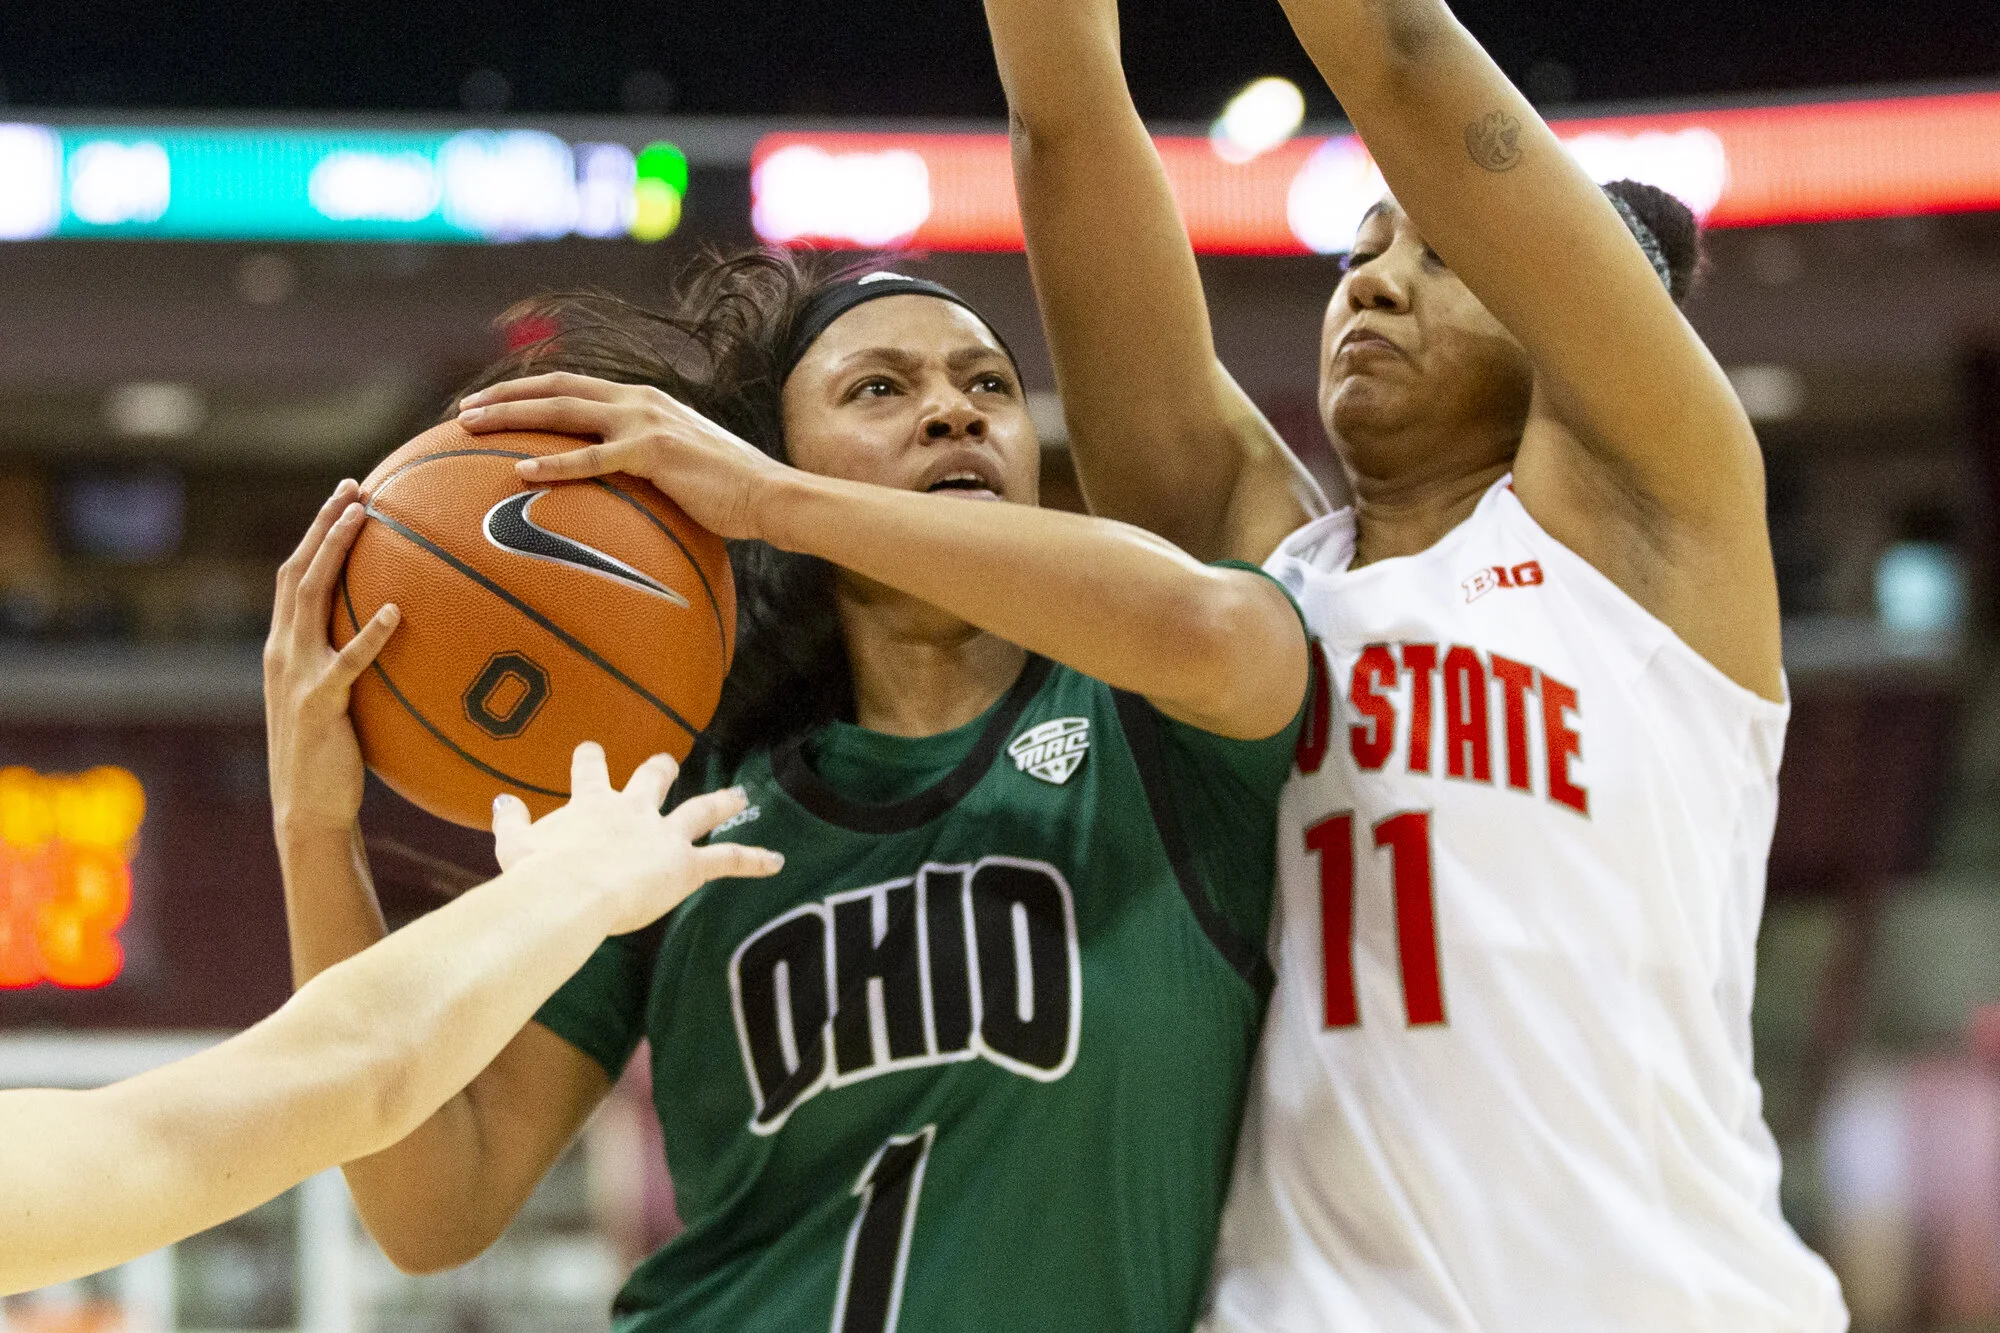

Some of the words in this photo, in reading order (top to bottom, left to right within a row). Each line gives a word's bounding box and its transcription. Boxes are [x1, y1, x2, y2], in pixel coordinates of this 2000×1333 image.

[1014, 731, 1090, 771] MAC
[1350, 641, 1592, 820] STATE
[729, 856, 1082, 1136] OHIO
[1304, 808, 1449, 1030] 11
[831, 1124, 937, 1333] 1
